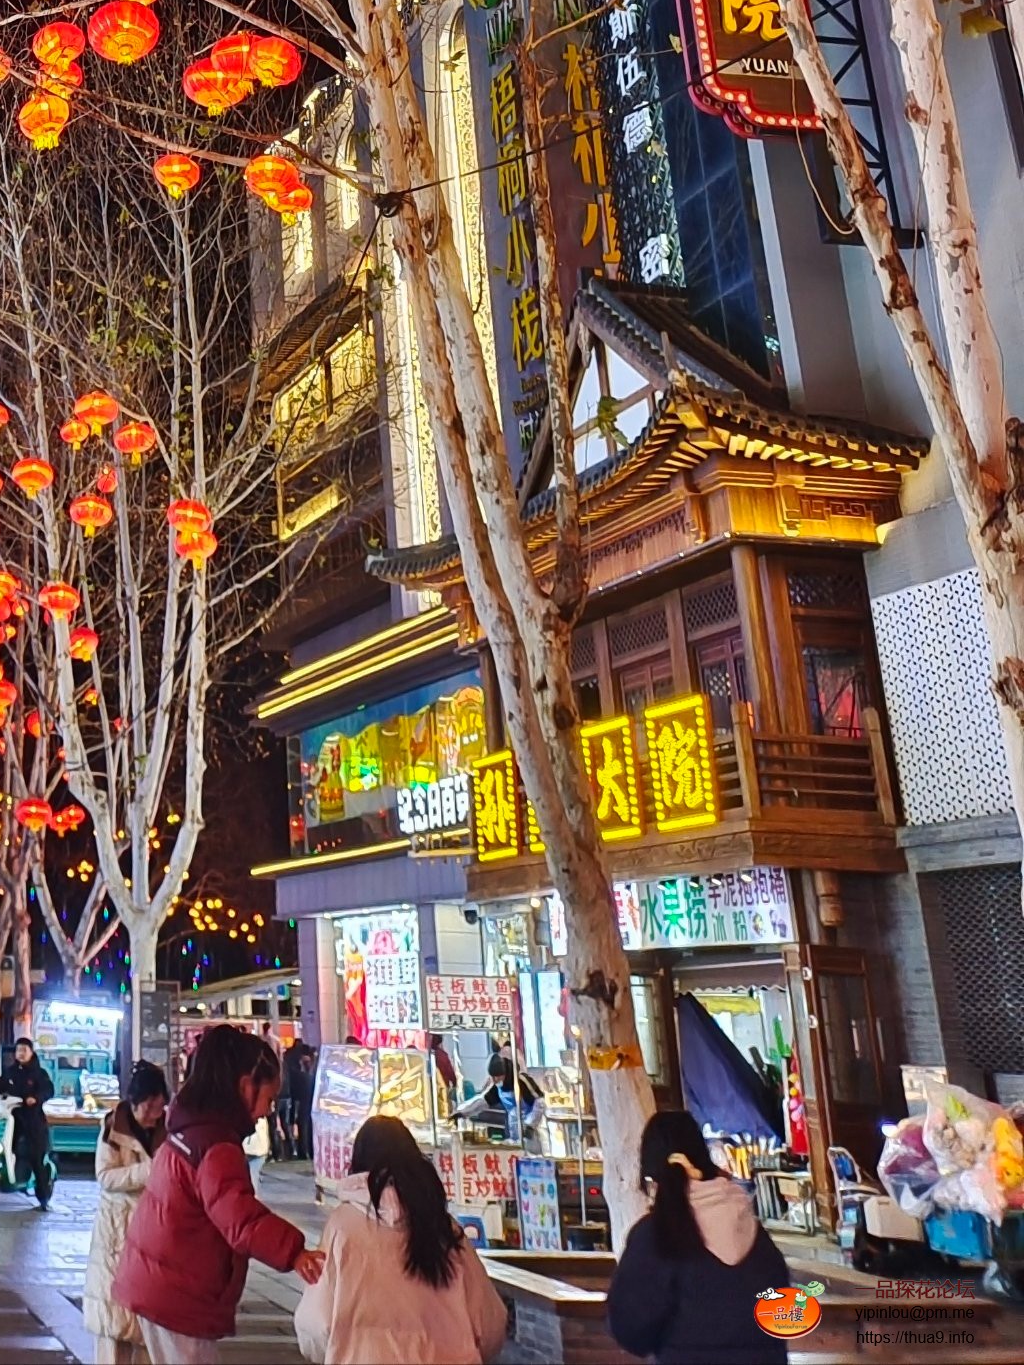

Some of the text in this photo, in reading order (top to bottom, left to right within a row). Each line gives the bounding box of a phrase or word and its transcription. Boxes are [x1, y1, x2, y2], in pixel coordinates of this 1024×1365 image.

[741, 57, 790, 76] YUAN
[489, 59, 544, 373] 梧桐小栈
[640, 877, 709, 943] 水果捞
[428, 977, 511, 996] 铁板鱿鱼
[429, 995, 513, 1014] 土豆炒鱿鱼
[446, 1013, 513, 1031] 臭豆腐
